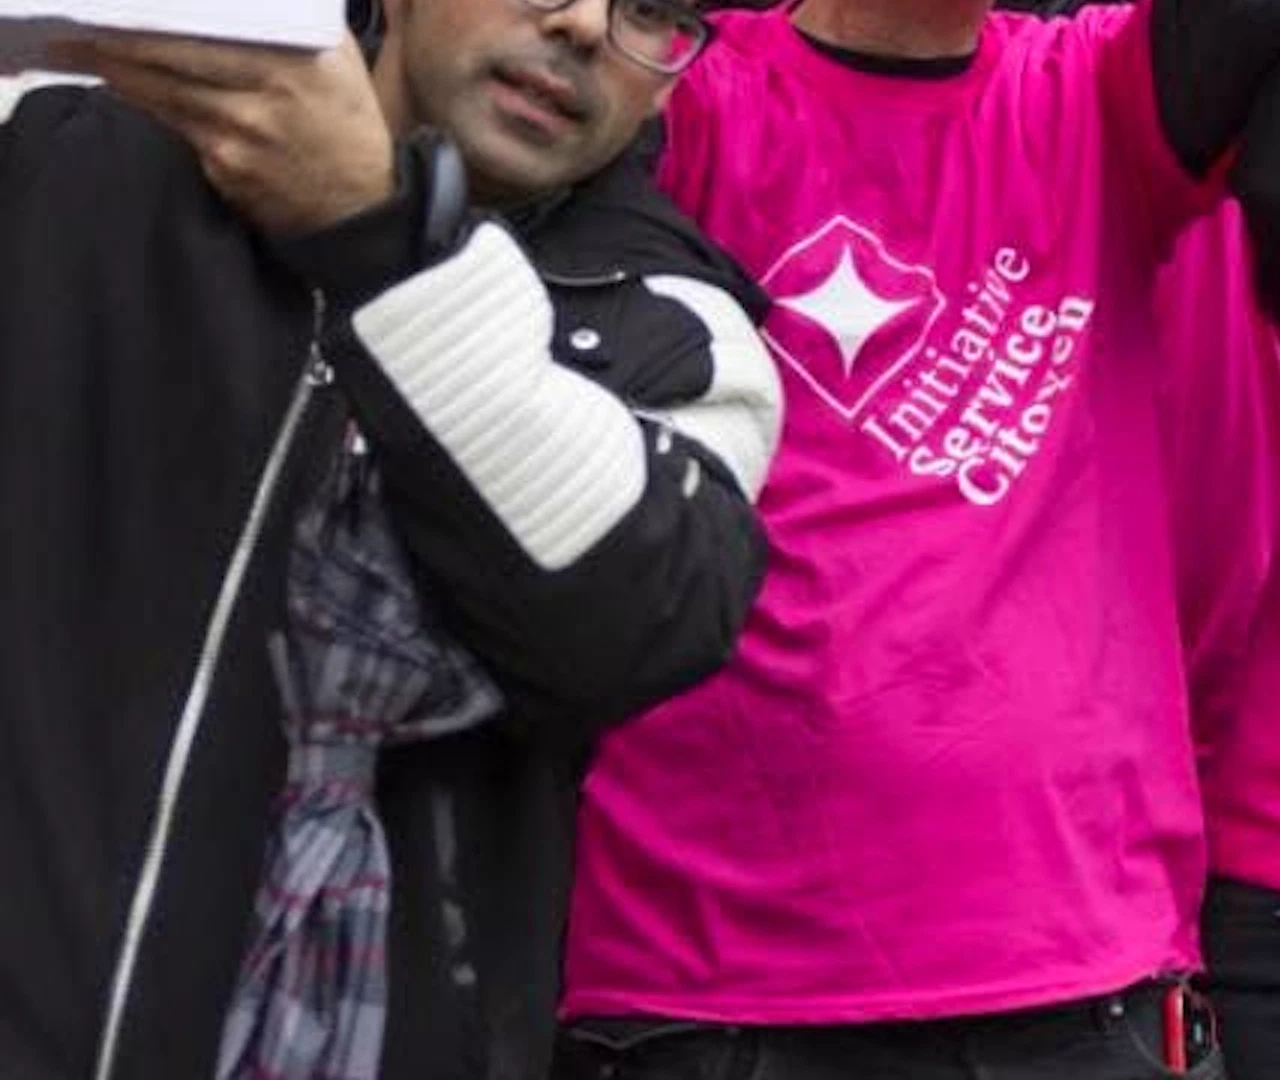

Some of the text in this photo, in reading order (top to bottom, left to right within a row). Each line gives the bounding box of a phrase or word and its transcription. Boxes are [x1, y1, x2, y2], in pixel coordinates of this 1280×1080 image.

[861, 246, 1031, 461] Initiative
[909, 304, 1057, 477] Service
[957, 296, 1096, 506] Citoyen
